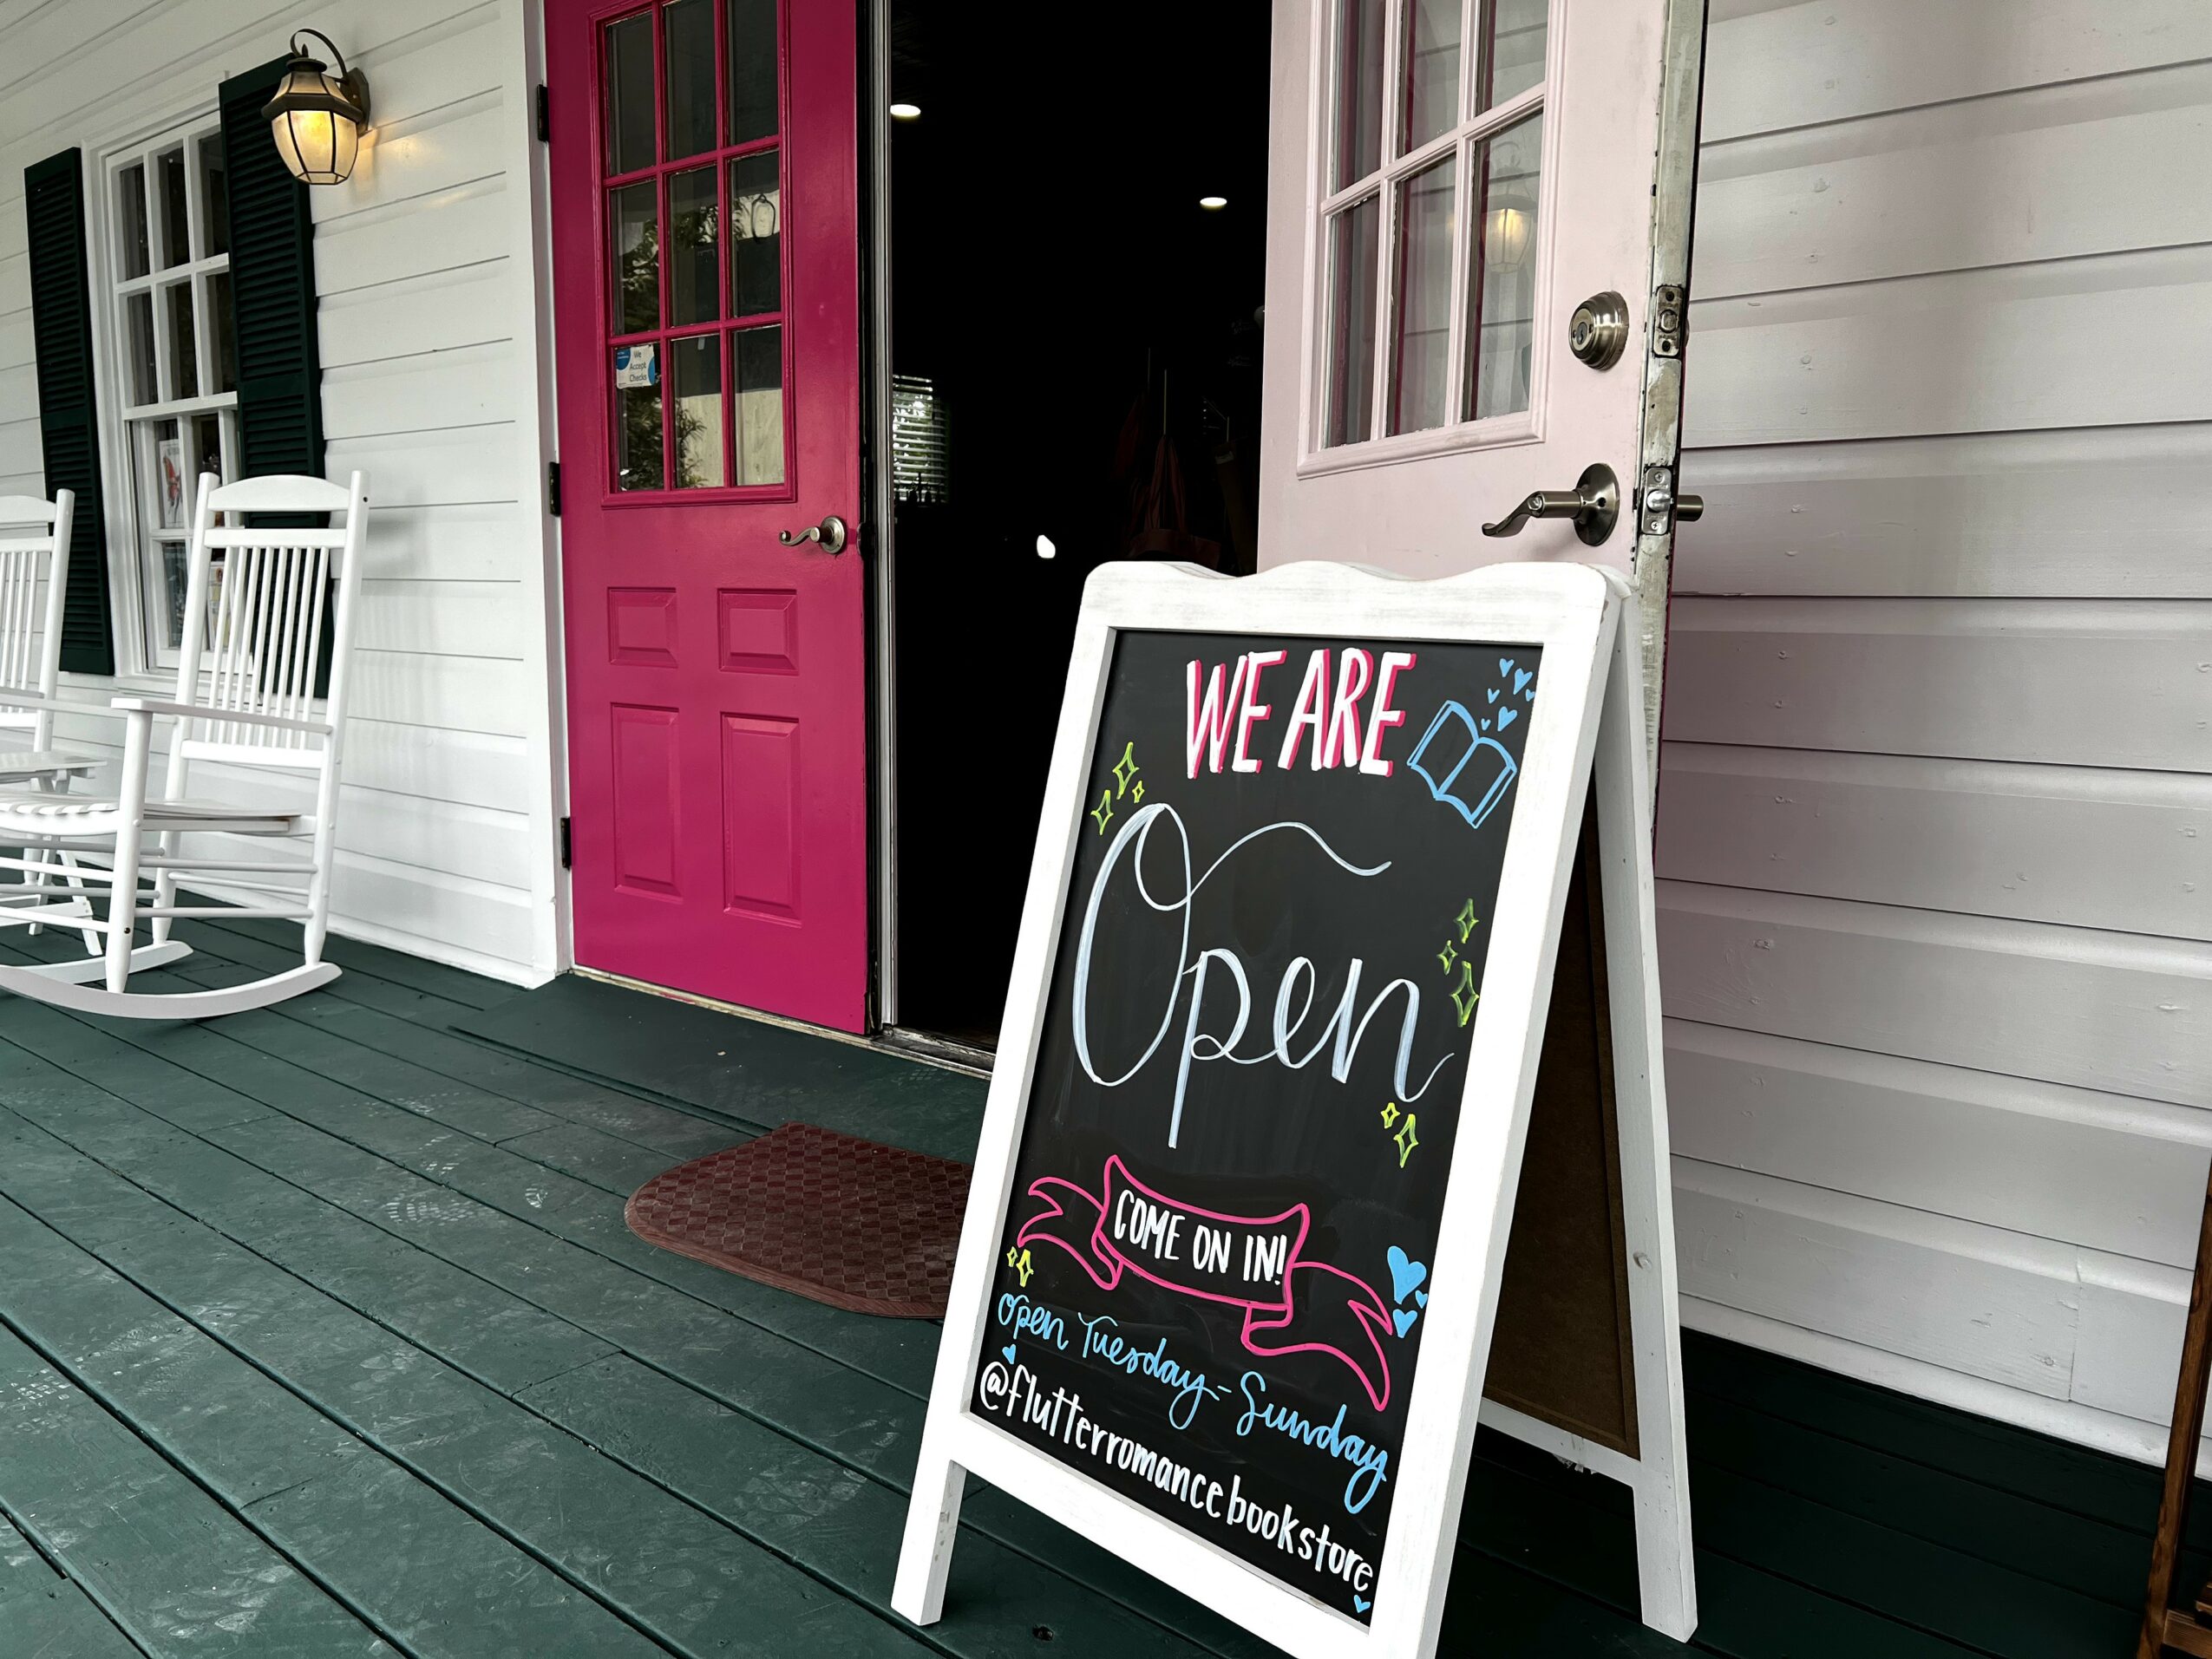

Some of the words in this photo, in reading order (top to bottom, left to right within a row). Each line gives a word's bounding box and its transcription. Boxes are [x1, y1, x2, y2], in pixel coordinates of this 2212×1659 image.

[630, 362, 646, 371] Accept
[630, 374, 646, 382] Checks
[634, 349, 642, 358] We
[1187, 650, 1287, 779] WE
[1278, 648, 1417, 776] ARE
[1072, 803, 1456, 1148] Open
[1114, 1189, 1186, 1260] COME
[1193, 1225, 1232, 1274] ON
[1242, 1234, 1287, 1286] IN!
